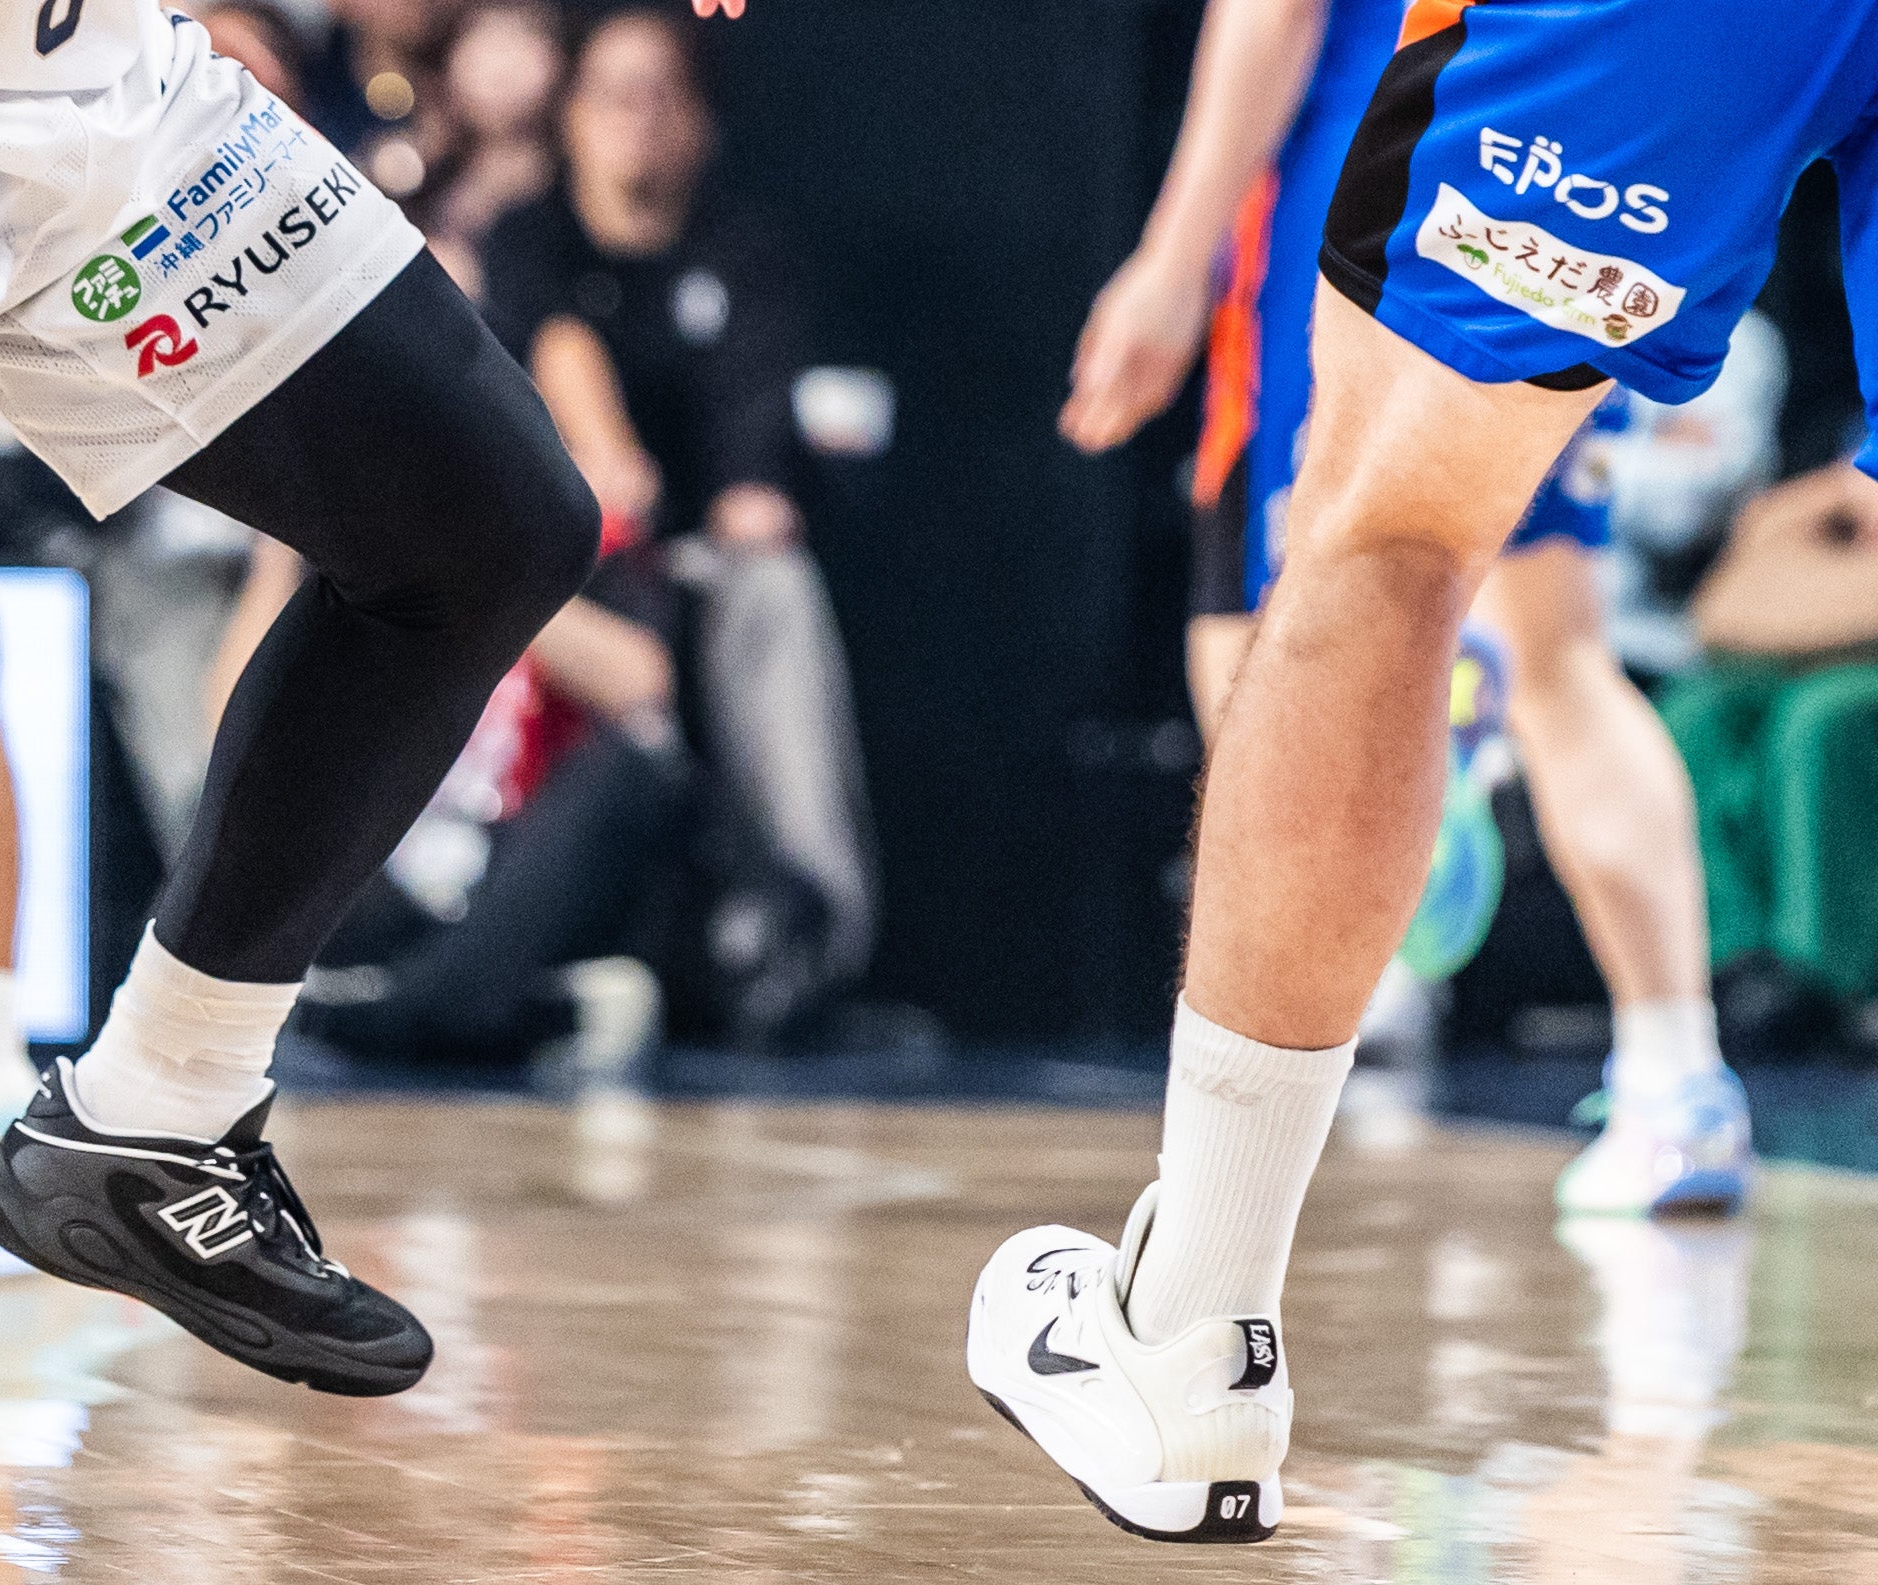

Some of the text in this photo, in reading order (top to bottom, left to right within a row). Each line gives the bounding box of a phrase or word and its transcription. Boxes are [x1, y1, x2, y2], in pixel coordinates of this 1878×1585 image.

[1479, 125, 1670, 234] EPOS
[183, 161, 362, 329] RYUSEKI
[1220, 1494, 1251, 1520] 07
